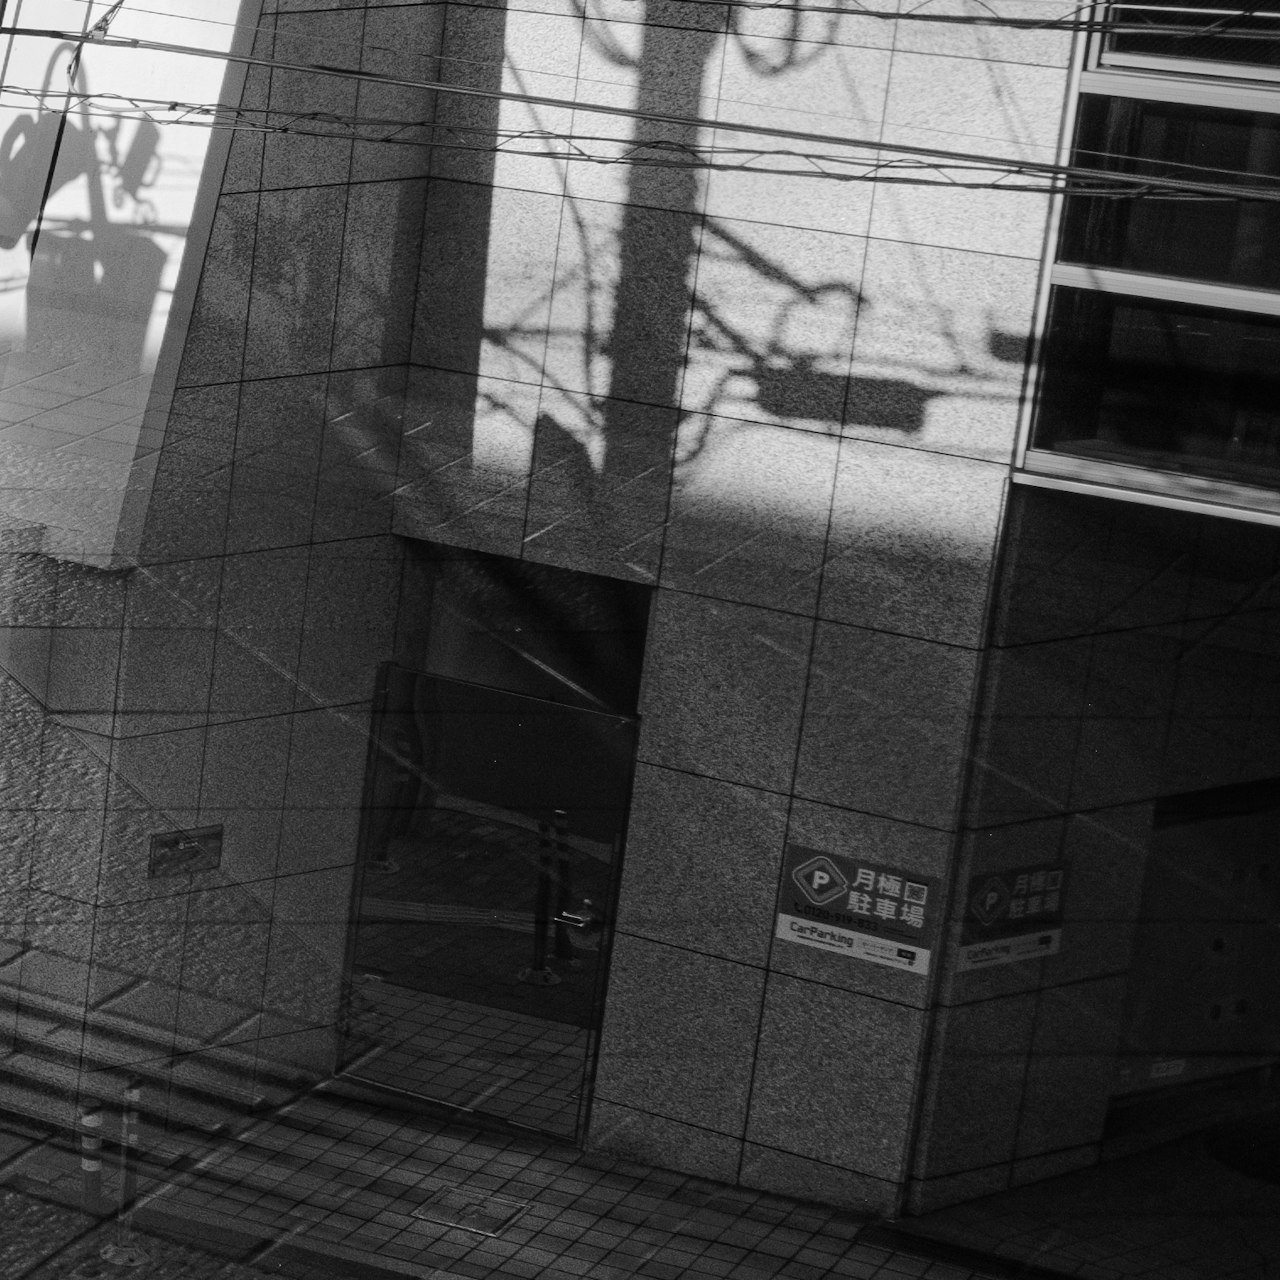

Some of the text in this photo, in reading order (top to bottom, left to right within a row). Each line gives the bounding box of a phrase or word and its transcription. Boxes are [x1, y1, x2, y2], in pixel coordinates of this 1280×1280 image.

[852, 868, 904, 898] 月極
[846, 891, 926, 928] 駐車場
[790, 921, 854, 948] CarParking
